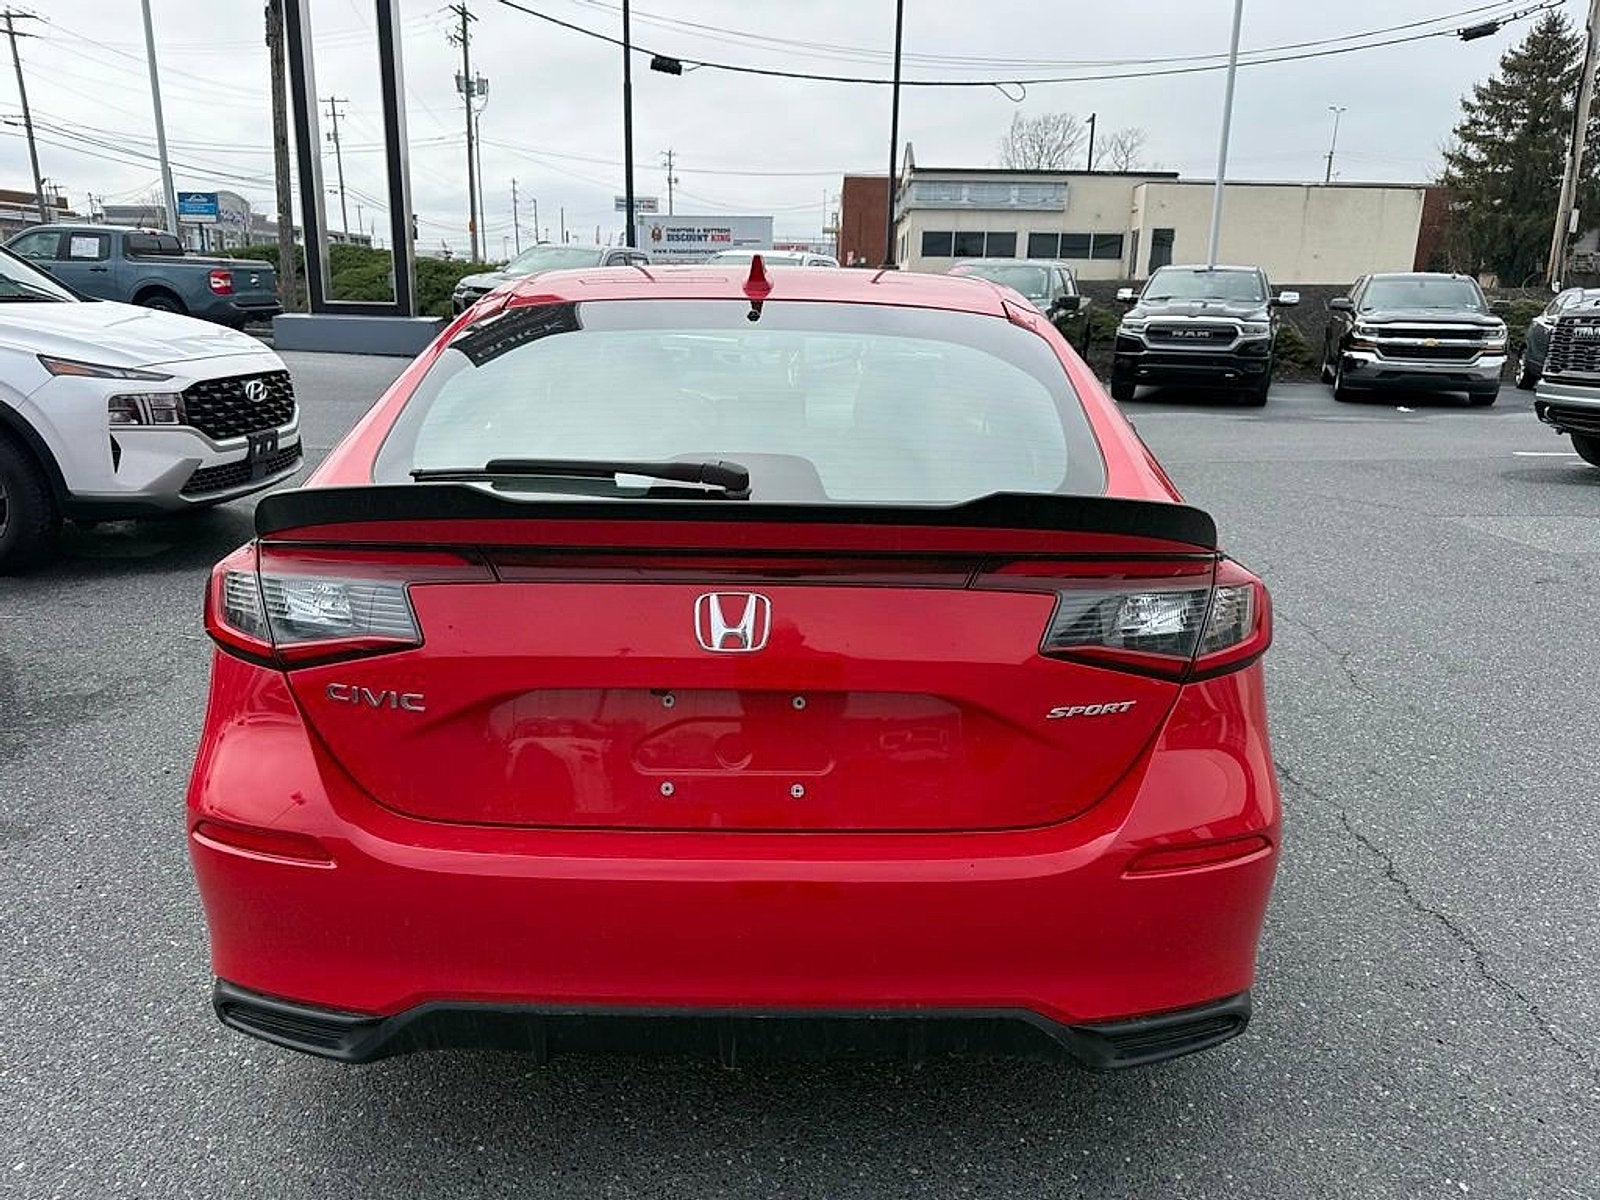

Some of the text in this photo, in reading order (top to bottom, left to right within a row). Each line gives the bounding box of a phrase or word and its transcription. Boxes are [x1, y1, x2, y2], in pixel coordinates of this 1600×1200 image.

[667, 234, 731, 242] DISCOUNT KING
[1171, 330, 1210, 338] RAM
[326, 683, 426, 712] CIVIC
[1046, 700, 1137, 719] SPORT
